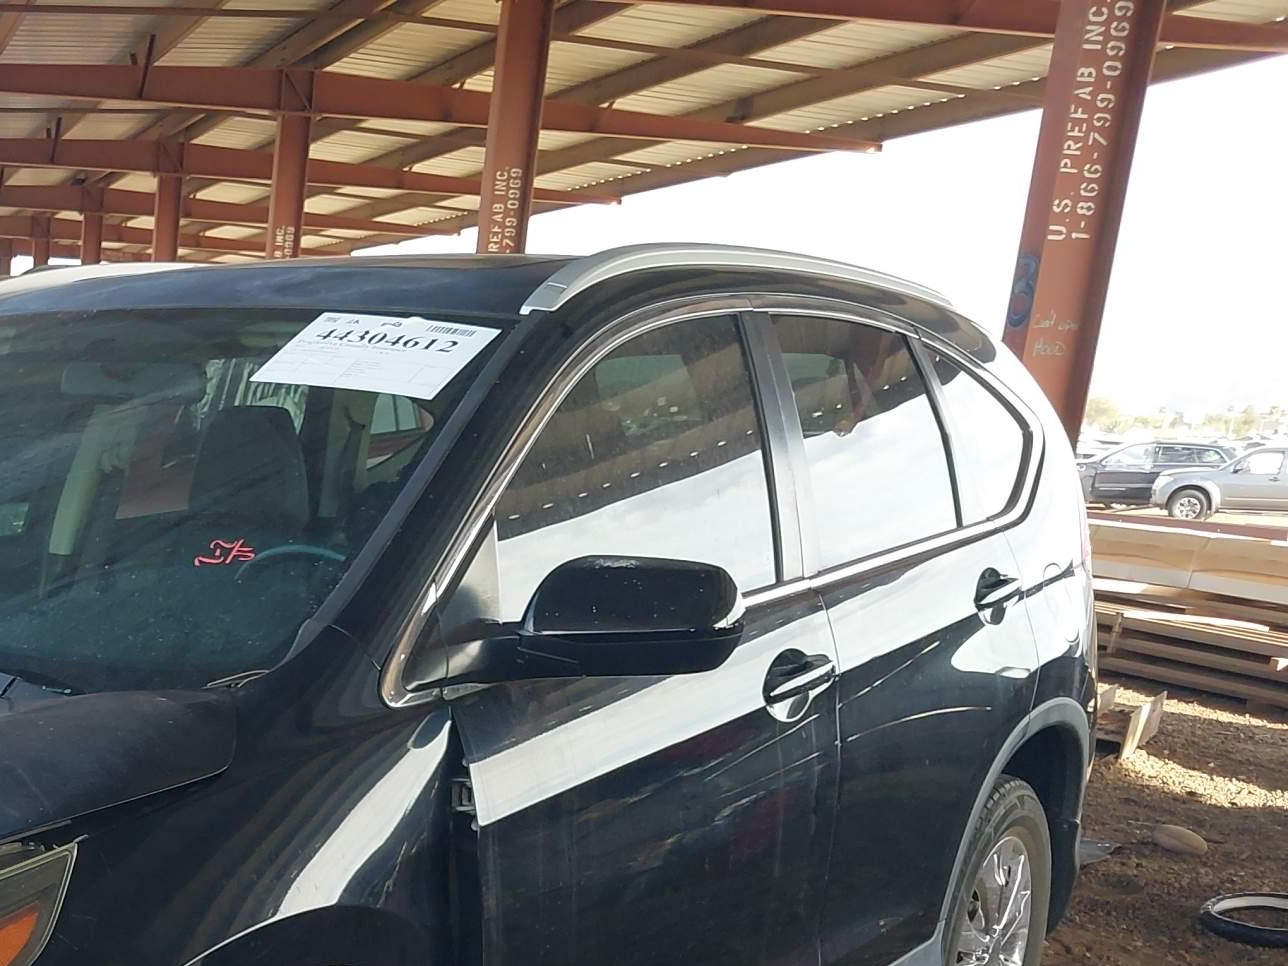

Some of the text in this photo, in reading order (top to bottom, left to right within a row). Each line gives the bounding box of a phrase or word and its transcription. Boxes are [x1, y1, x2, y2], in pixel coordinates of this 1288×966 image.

[1060, 66, 1096, 174] PREFAB
[487, 203, 505, 252] REFAB
[316, 328, 460, 353] 44304612
